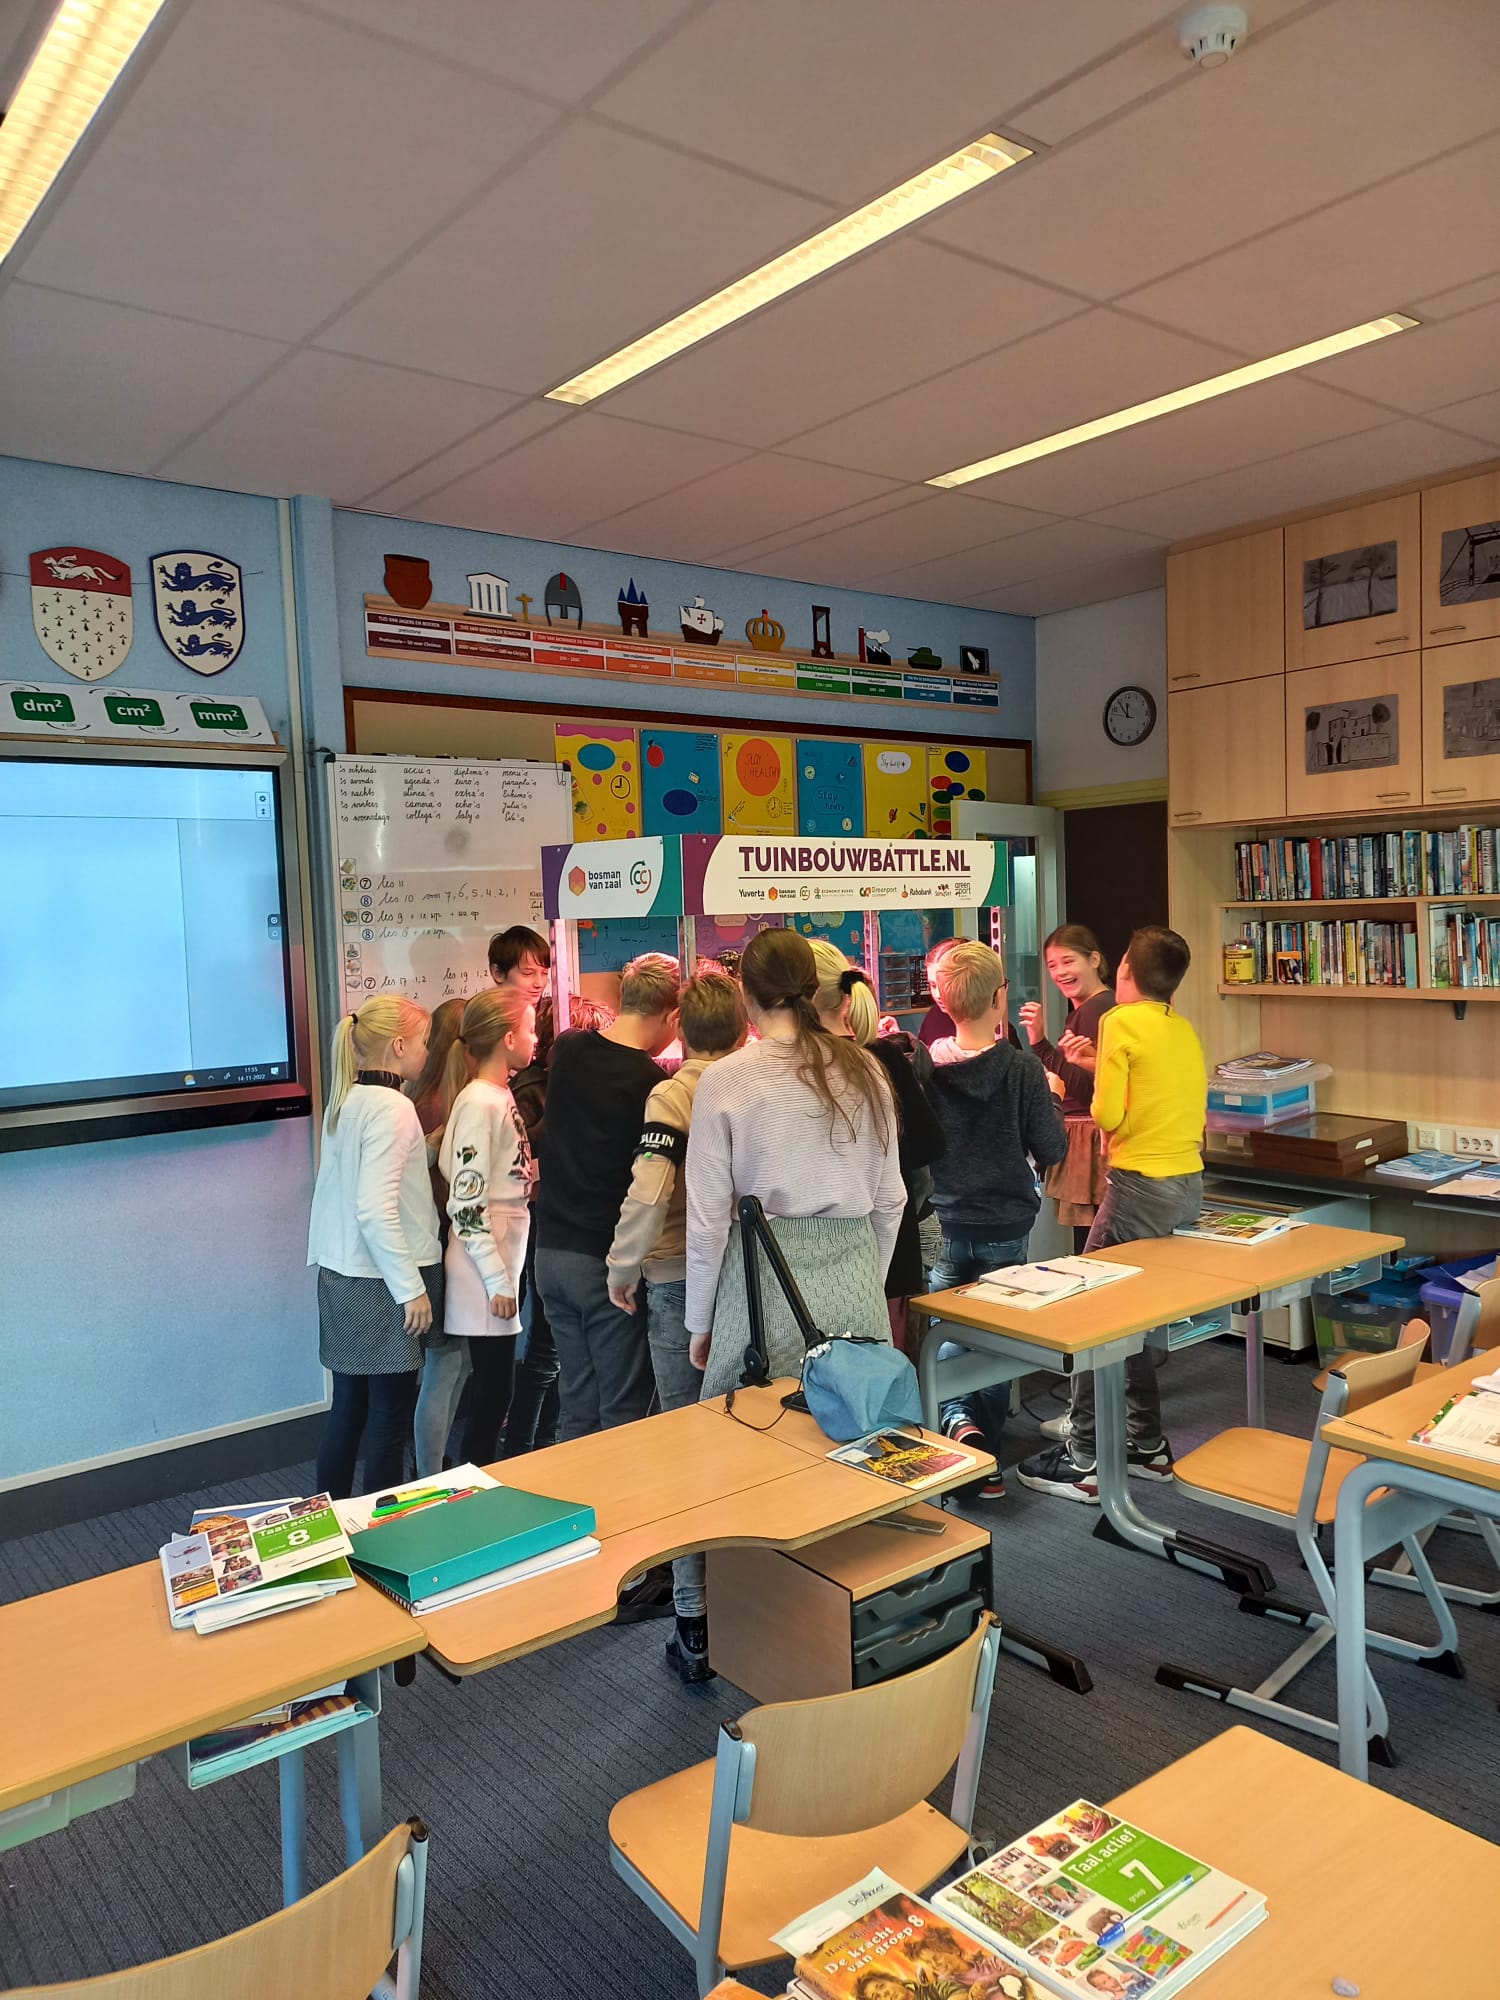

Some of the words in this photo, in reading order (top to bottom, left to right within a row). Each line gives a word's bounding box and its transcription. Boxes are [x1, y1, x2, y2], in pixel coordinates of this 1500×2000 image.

[738, 846, 971, 872] TUINBOUWBATTLE.NL
[588, 870, 620, 881] bosman
[588, 882, 604, 890] van
[604, 880, 622, 889] zaal
[738, 888, 765, 898] Yuverta
[909, 888, 932, 896] Rabobank
[258, 1523, 288, 1537] Taal
[290, 1510, 329, 1528] actief
[287, 1528, 310, 1546] 8
[1067, 1851, 1104, 1877] Taal
[1098, 1828, 1138, 1860] actief
[1118, 1858, 1165, 1892] 7
[824, 1958, 849, 1975] De
[848, 1926, 895, 1958] kracht
[847, 1953, 874, 1974] van
[874, 1926, 914, 1956] groep
[907, 1914, 926, 1928] 8
